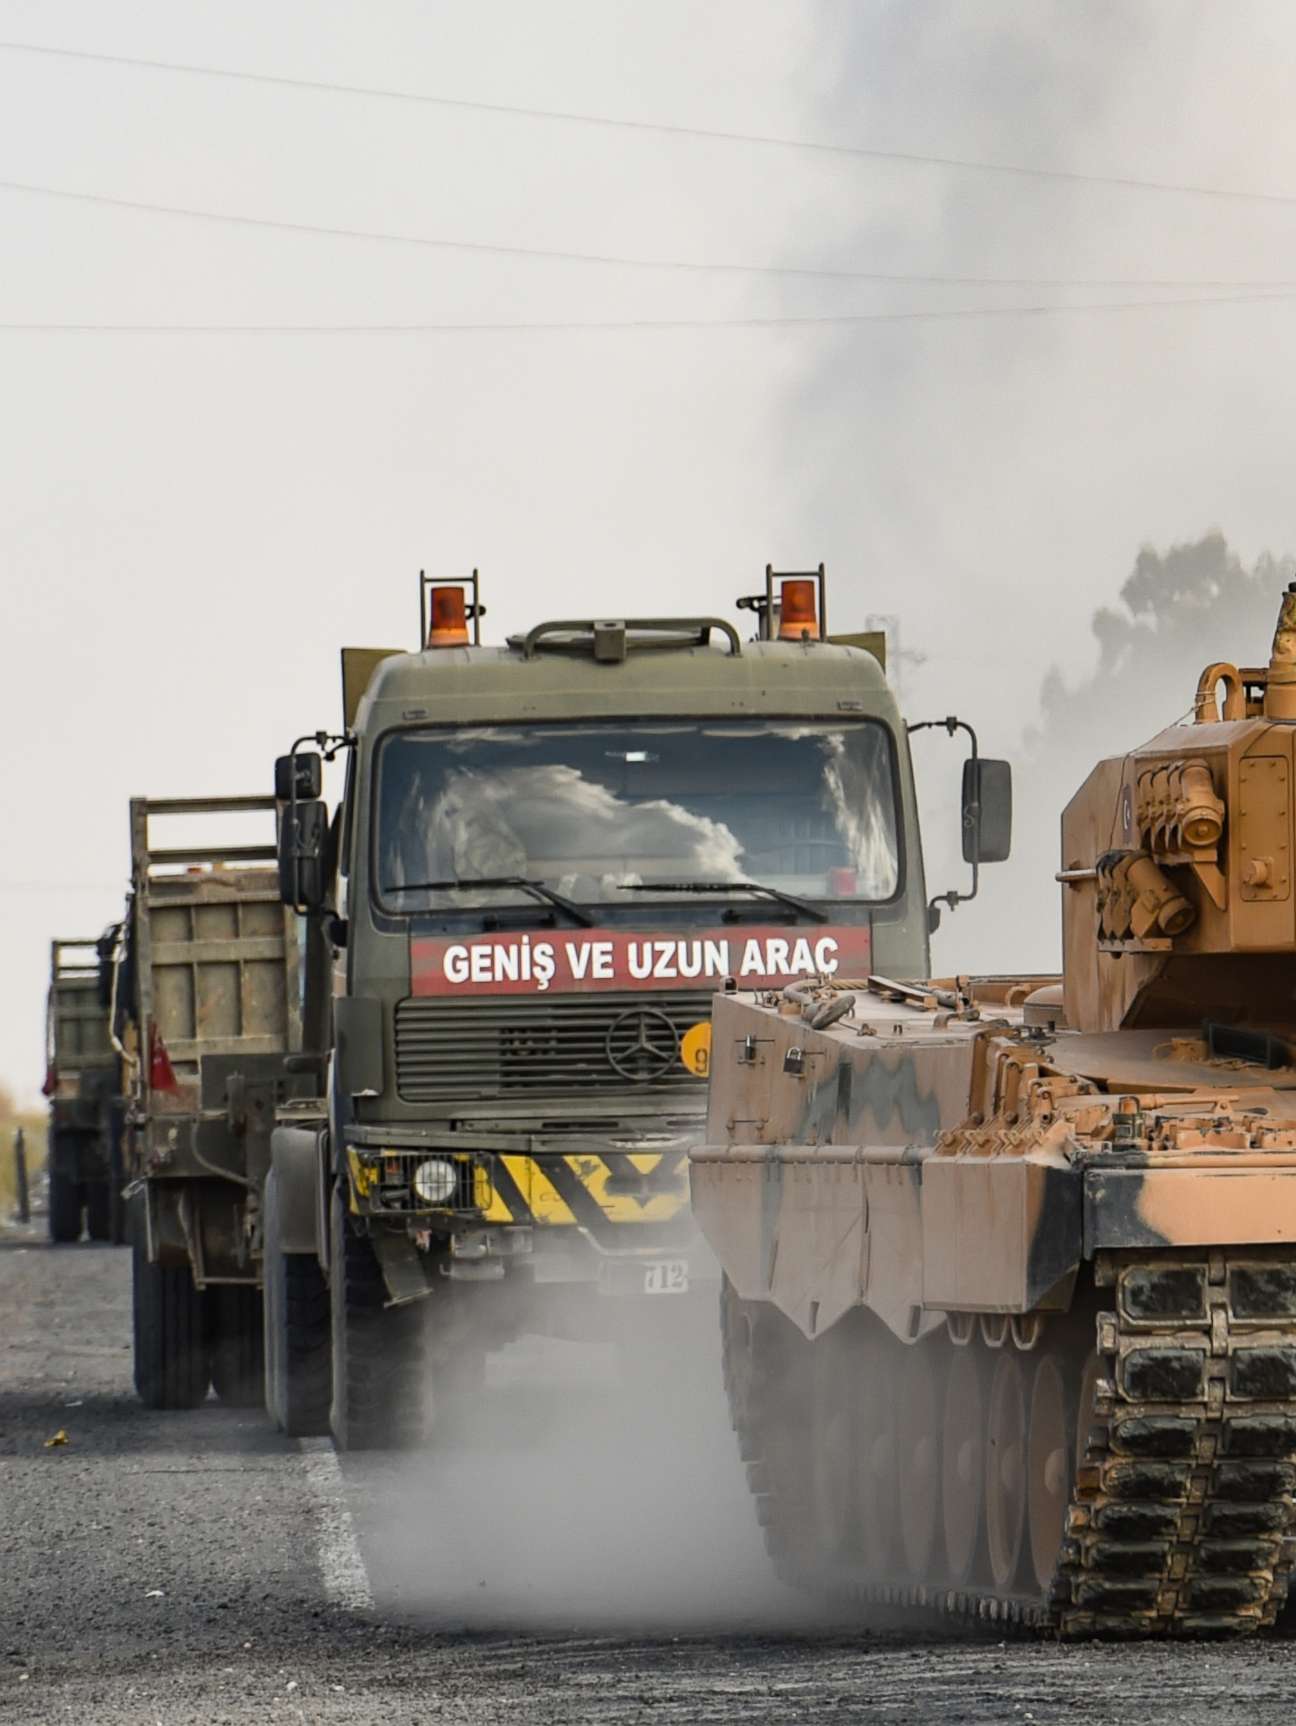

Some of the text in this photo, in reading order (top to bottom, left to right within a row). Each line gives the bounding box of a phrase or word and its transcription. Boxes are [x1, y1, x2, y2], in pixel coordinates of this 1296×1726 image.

[443, 935, 556, 990] GENİŞ
[566, 942, 614, 979] VE
[628, 939, 730, 978] UZUN
